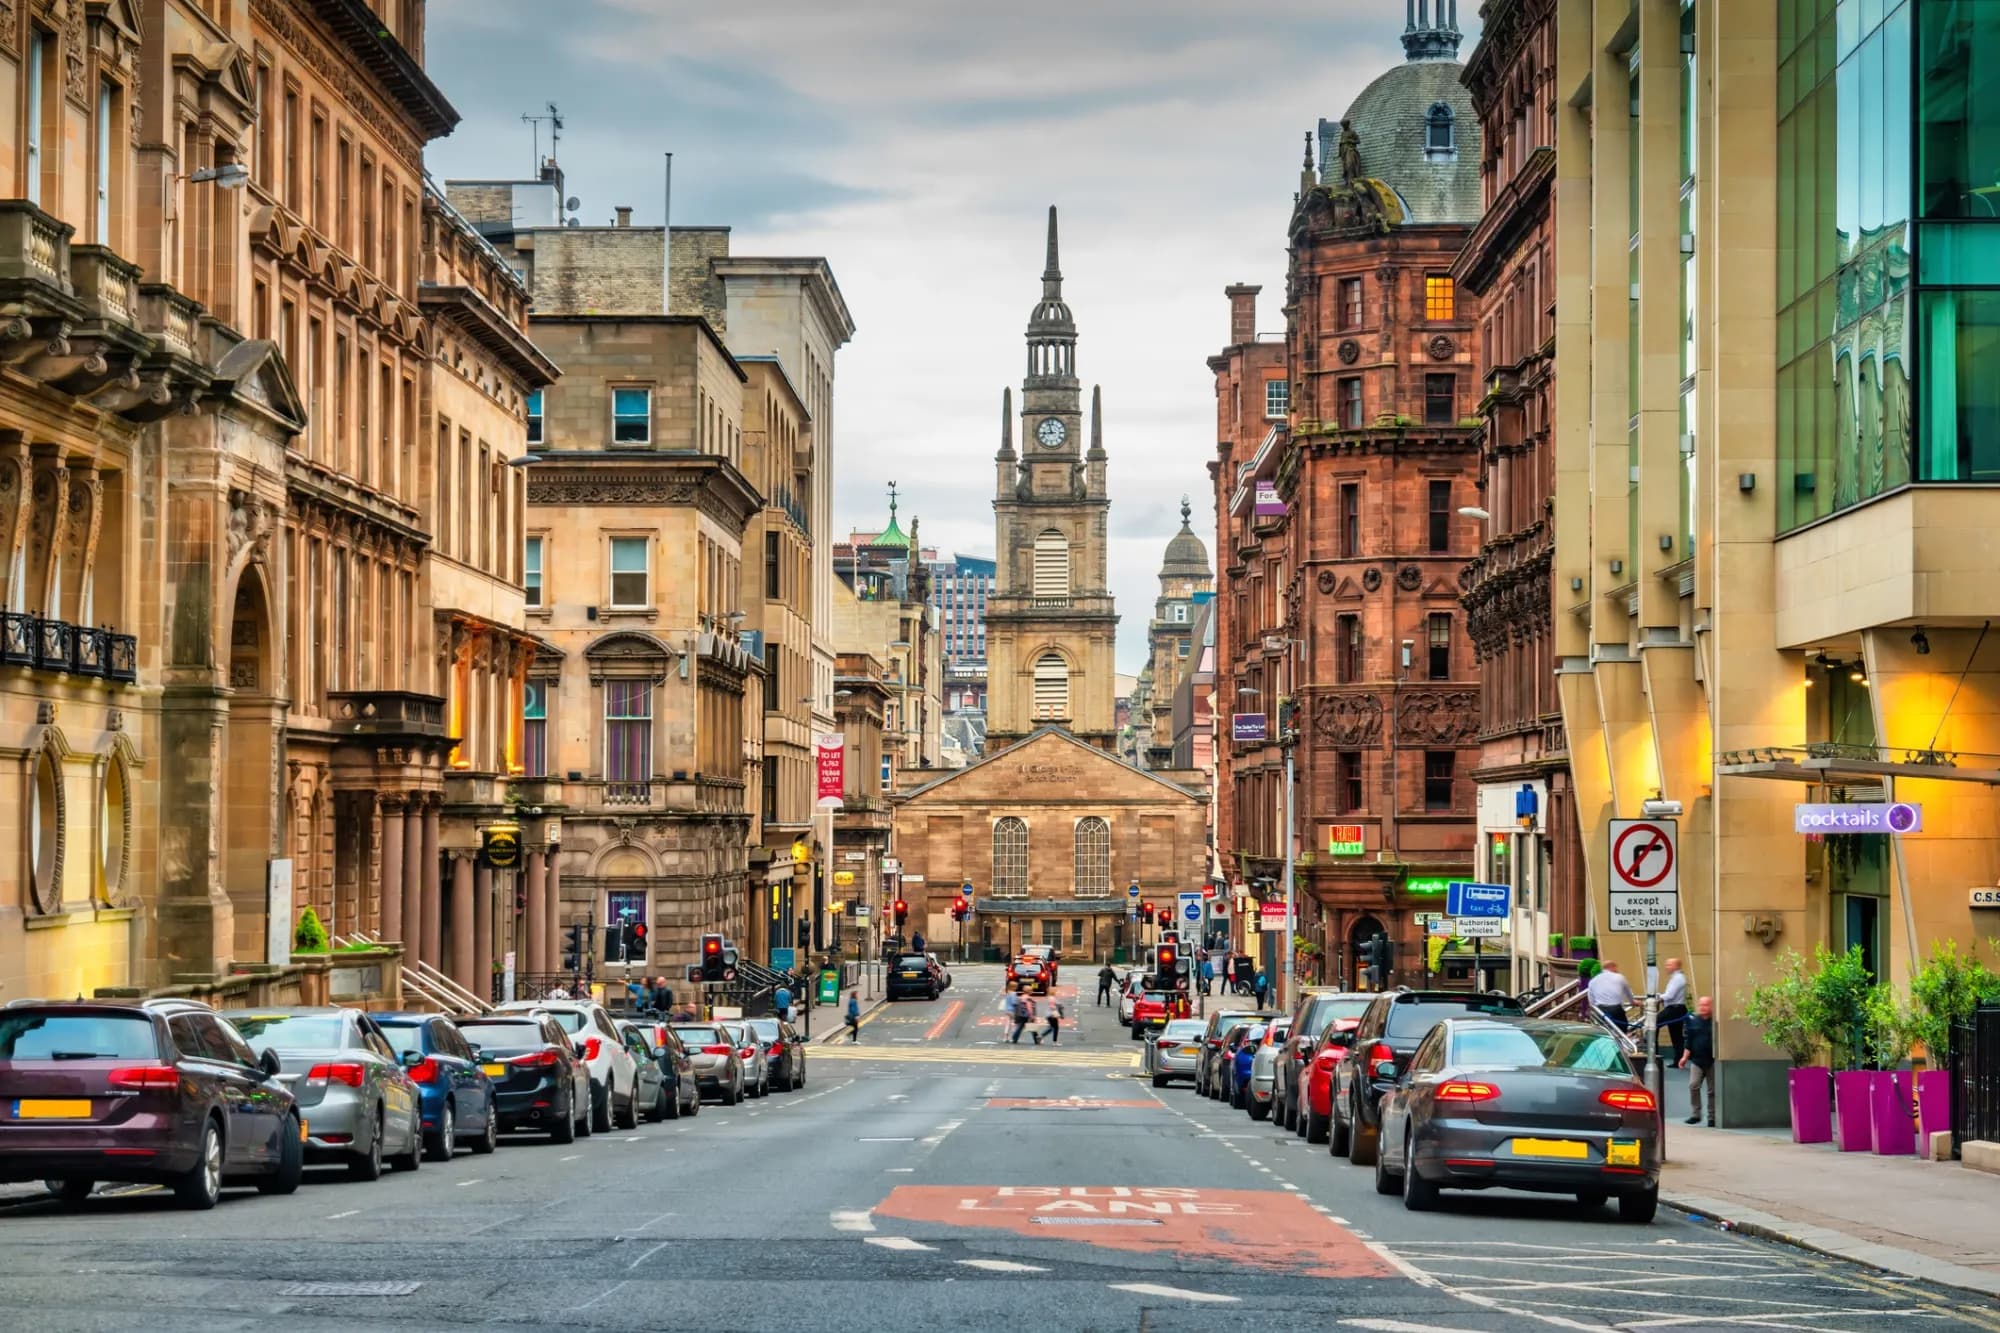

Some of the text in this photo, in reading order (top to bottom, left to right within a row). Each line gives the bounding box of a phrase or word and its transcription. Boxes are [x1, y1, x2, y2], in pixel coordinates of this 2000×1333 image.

[1800, 809, 1880, 827] cocktails
[1627, 897, 1659, 905] except
[1649, 906, 1672, 916] taxis
[1639, 918, 1669, 927] cycles
[997, 1186, 1201, 1198] BUS
[958, 1199, 1253, 1215] LANE
